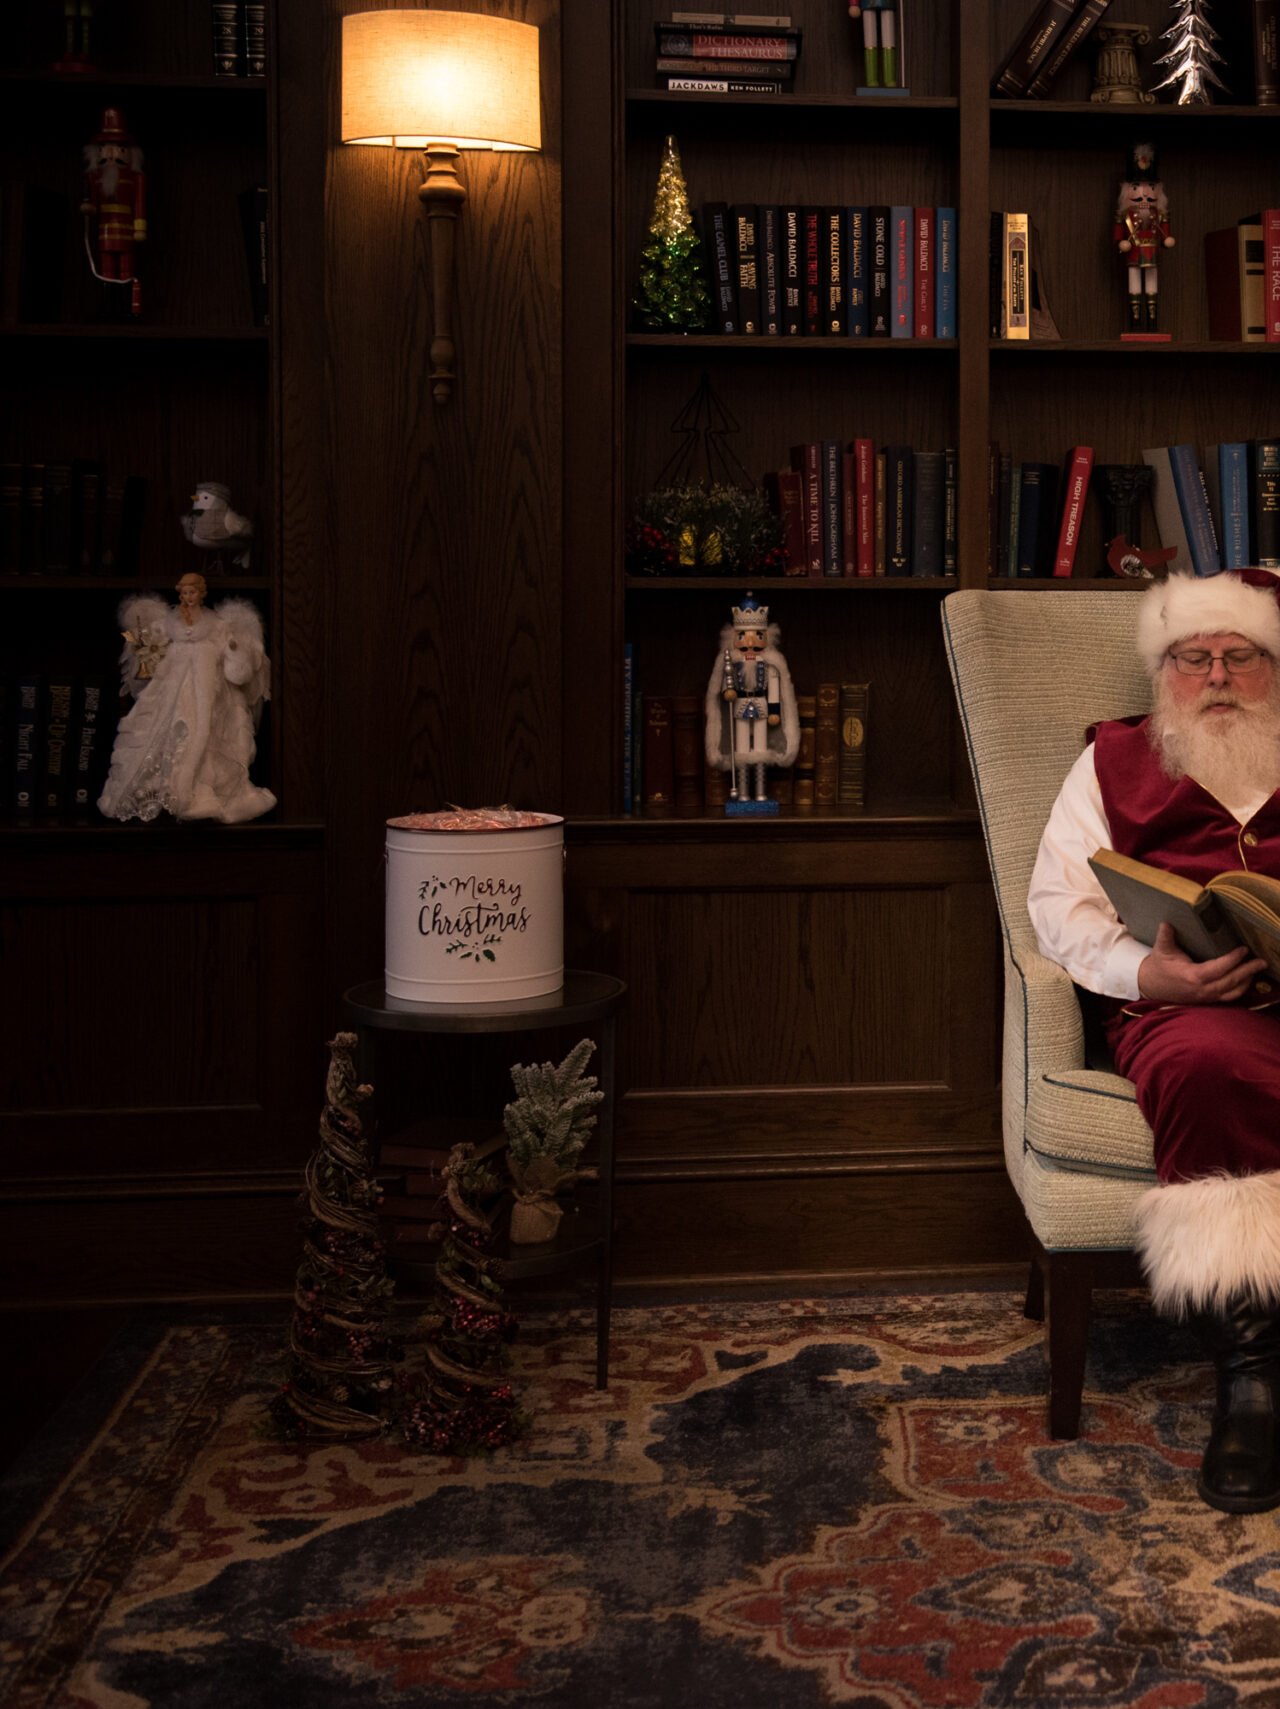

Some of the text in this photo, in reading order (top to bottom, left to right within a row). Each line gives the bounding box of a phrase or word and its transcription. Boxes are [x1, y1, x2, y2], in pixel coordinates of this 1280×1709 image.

[698, 35, 780, 47] DICTIONARY
[710, 47, 784, 59] THESAURUS
[671, 81, 725, 91] JACKDAWS
[743, 65, 770, 74] TARGET
[714, 214, 729, 281] THE CAMEL CLUB
[738, 217, 747, 252] BALDACCI
[746, 223, 755, 245] DAVID
[787, 212, 798, 278] DAVID BALDACCI
[807, 213, 819, 285] THE WHOLE TRUTH
[829, 214, 840, 282] THE COLLECTORS
[852, 213, 863, 278] DAVID BALDACCI
[875, 217, 886, 266] STONE COLD
[919, 218, 929, 271] DAVID BALDACCI
[942, 219, 951, 272] DAVID BALDACCI
[739, 264, 748, 288] FAITH
[748, 262, 757, 290] SAVING
[766, 252, 777, 315] ABSOLUTE POWER
[920, 279, 928, 312] THE GUILTY
[829, 446, 837, 497] THE BRETHREN
[1073, 476, 1083, 500] HIGH
[809, 481, 818, 507] TIME
[810, 509, 819, 522] TO
[1065, 502, 1079, 546] TREASON
[807, 523, 819, 545] KILL
[830, 523, 838, 559] GRISHAM
[17, 723, 35, 751] NIGHT
[16, 752, 33, 772] FALL
[449, 875, 522, 906] Merry
[418, 903, 532, 938] Christmas
